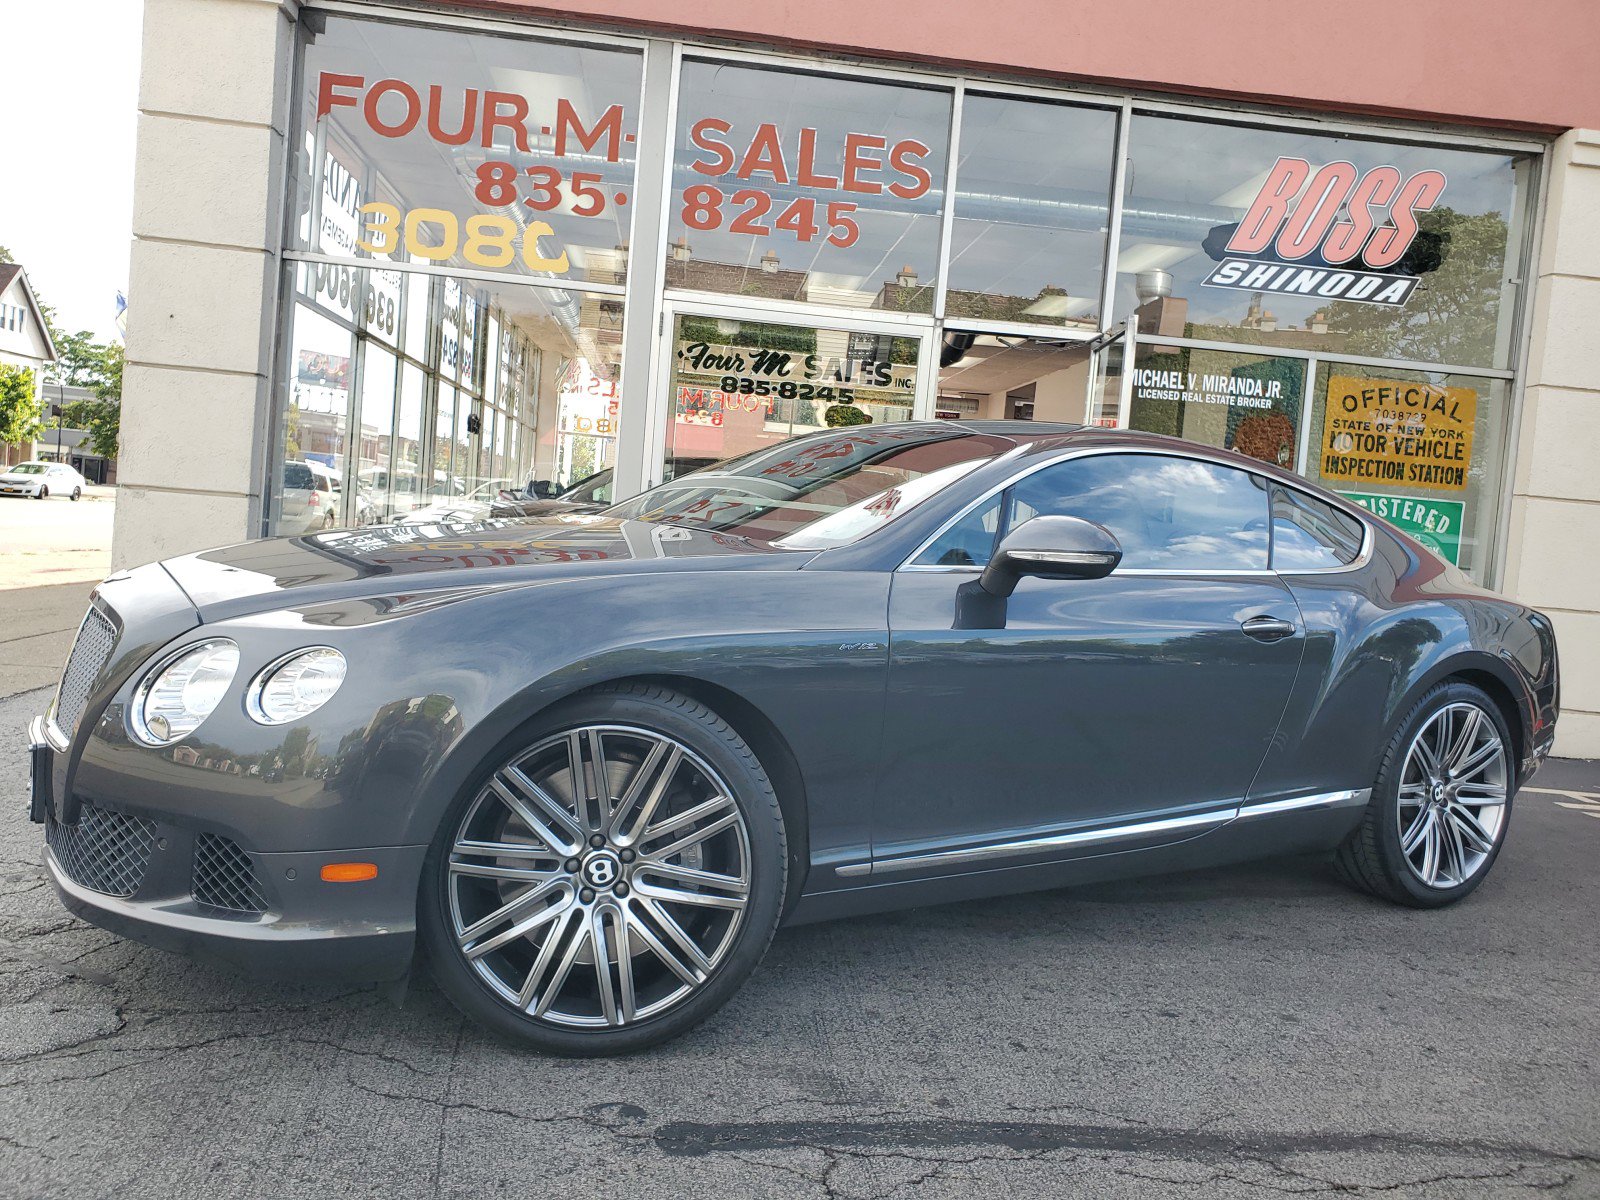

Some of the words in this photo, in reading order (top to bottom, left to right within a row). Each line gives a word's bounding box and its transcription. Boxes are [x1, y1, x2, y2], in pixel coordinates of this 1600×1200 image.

[689, 118, 933, 200] SALES
[681, 184, 860, 248] 8245
[1224, 156, 1448, 268] BOSS
[1212, 262, 1411, 303] SHINODA
[749, 349, 791, 377] M
[804, 354, 892, 387] SALES
[894, 377, 914, 389] INC.
[1188, 373, 1199, 391] V.
[1202, 374, 1263, 397] MIRANDA
[1265, 379, 1284, 399] JR.
[1138, 388, 1180, 402] LICENSED
[1181, 392, 1203, 403] REAL
[1205, 394, 1236, 406] ESTATE
[1238, 397, 1272, 409] BROKER
[1342, 387, 1463, 424] OFFICIAL
[1333, 418, 1371, 431] STATE
[1376, 422, 1392, 433] OF
[1397, 424, 1426, 437] NEW
[1431, 427, 1465, 440] YORK
[1393, 436, 1466, 461] VEHICLE
[1325, 455, 1406, 481] INSPECTION
[1408, 463, 1464, 486] STATION
